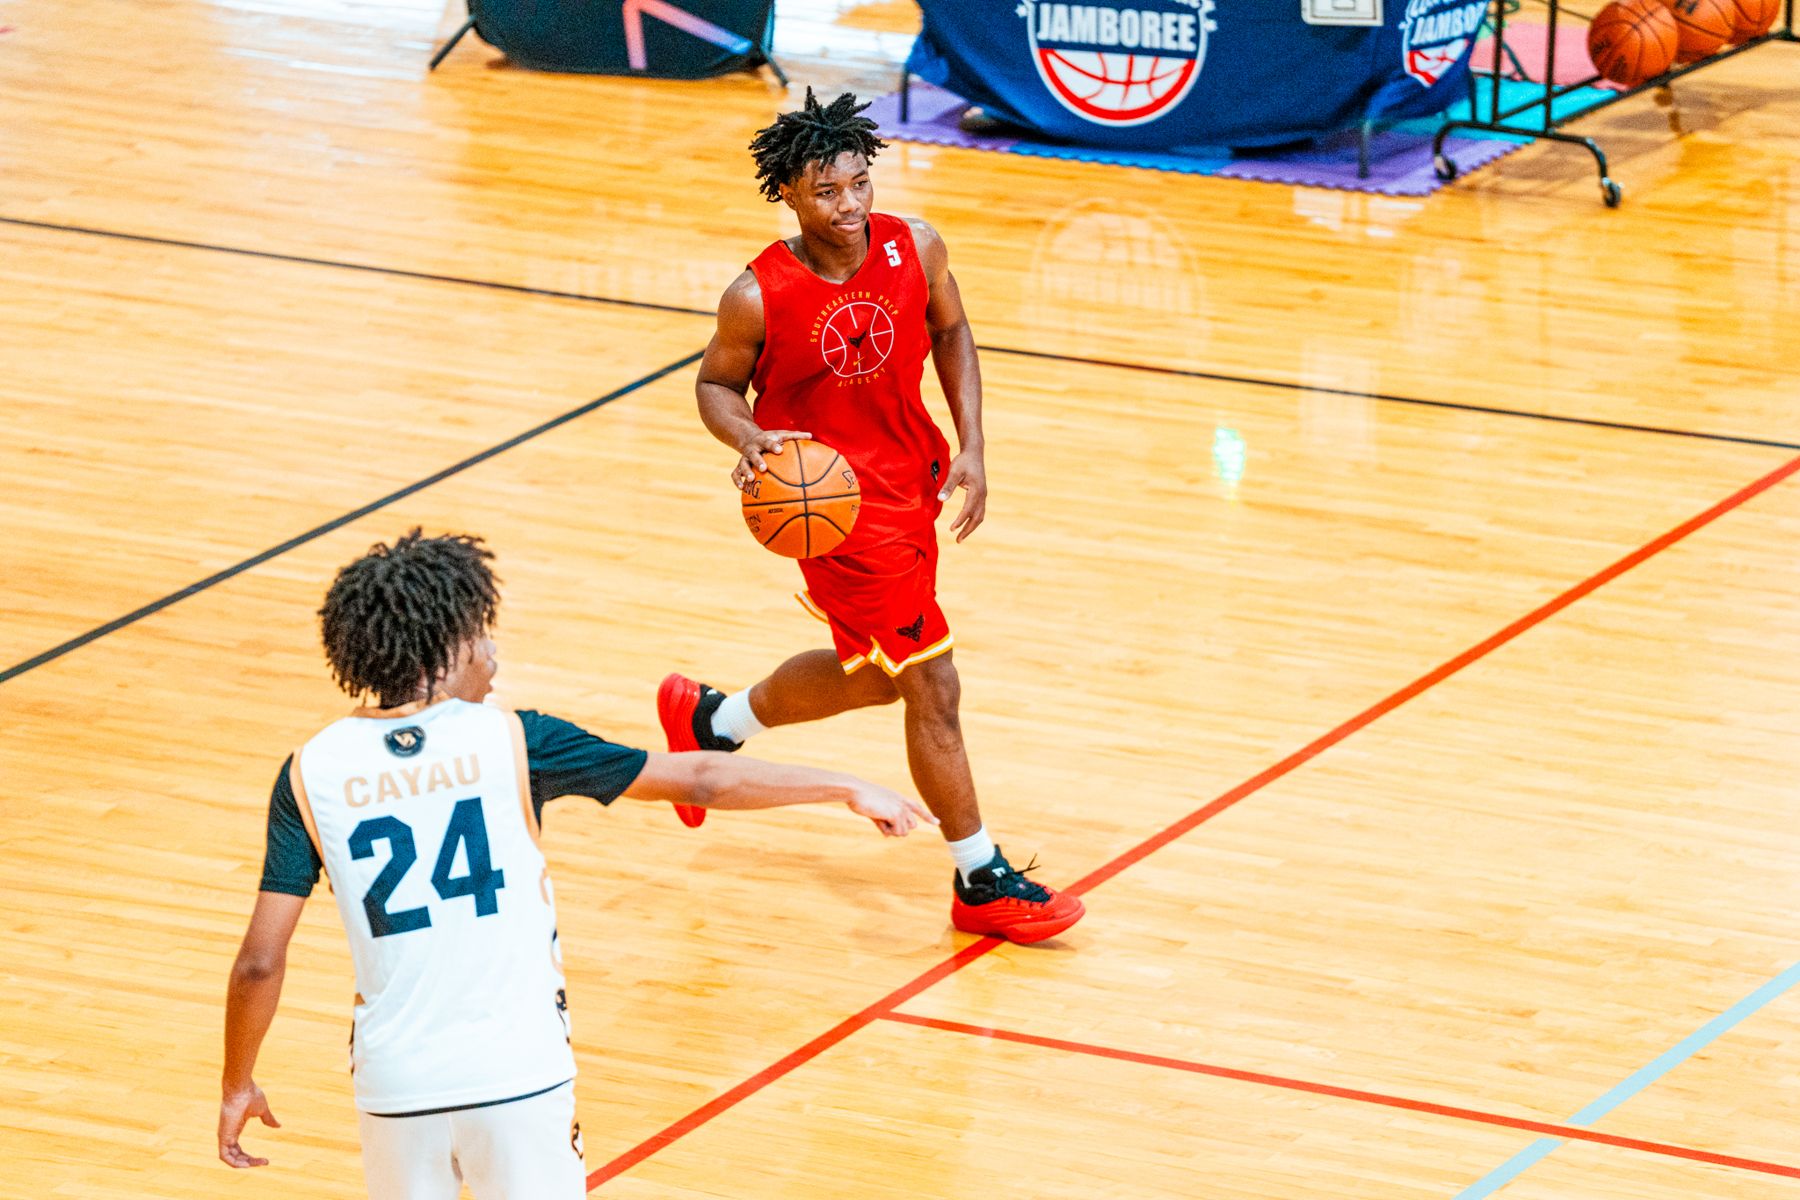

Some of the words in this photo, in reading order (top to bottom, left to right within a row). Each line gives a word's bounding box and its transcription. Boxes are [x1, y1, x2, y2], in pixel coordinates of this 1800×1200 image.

[1036, 2, 1197, 52] JAMBOREE
[882, 239, 902, 268] 5
[809, 290, 871, 343] SOUTHEASTERN
[877, 294, 900, 317] PREP
[837, 366, 886, 388] ACADEMY
[344, 753, 482, 809] CAYAU
[347, 796, 506, 938] 24
